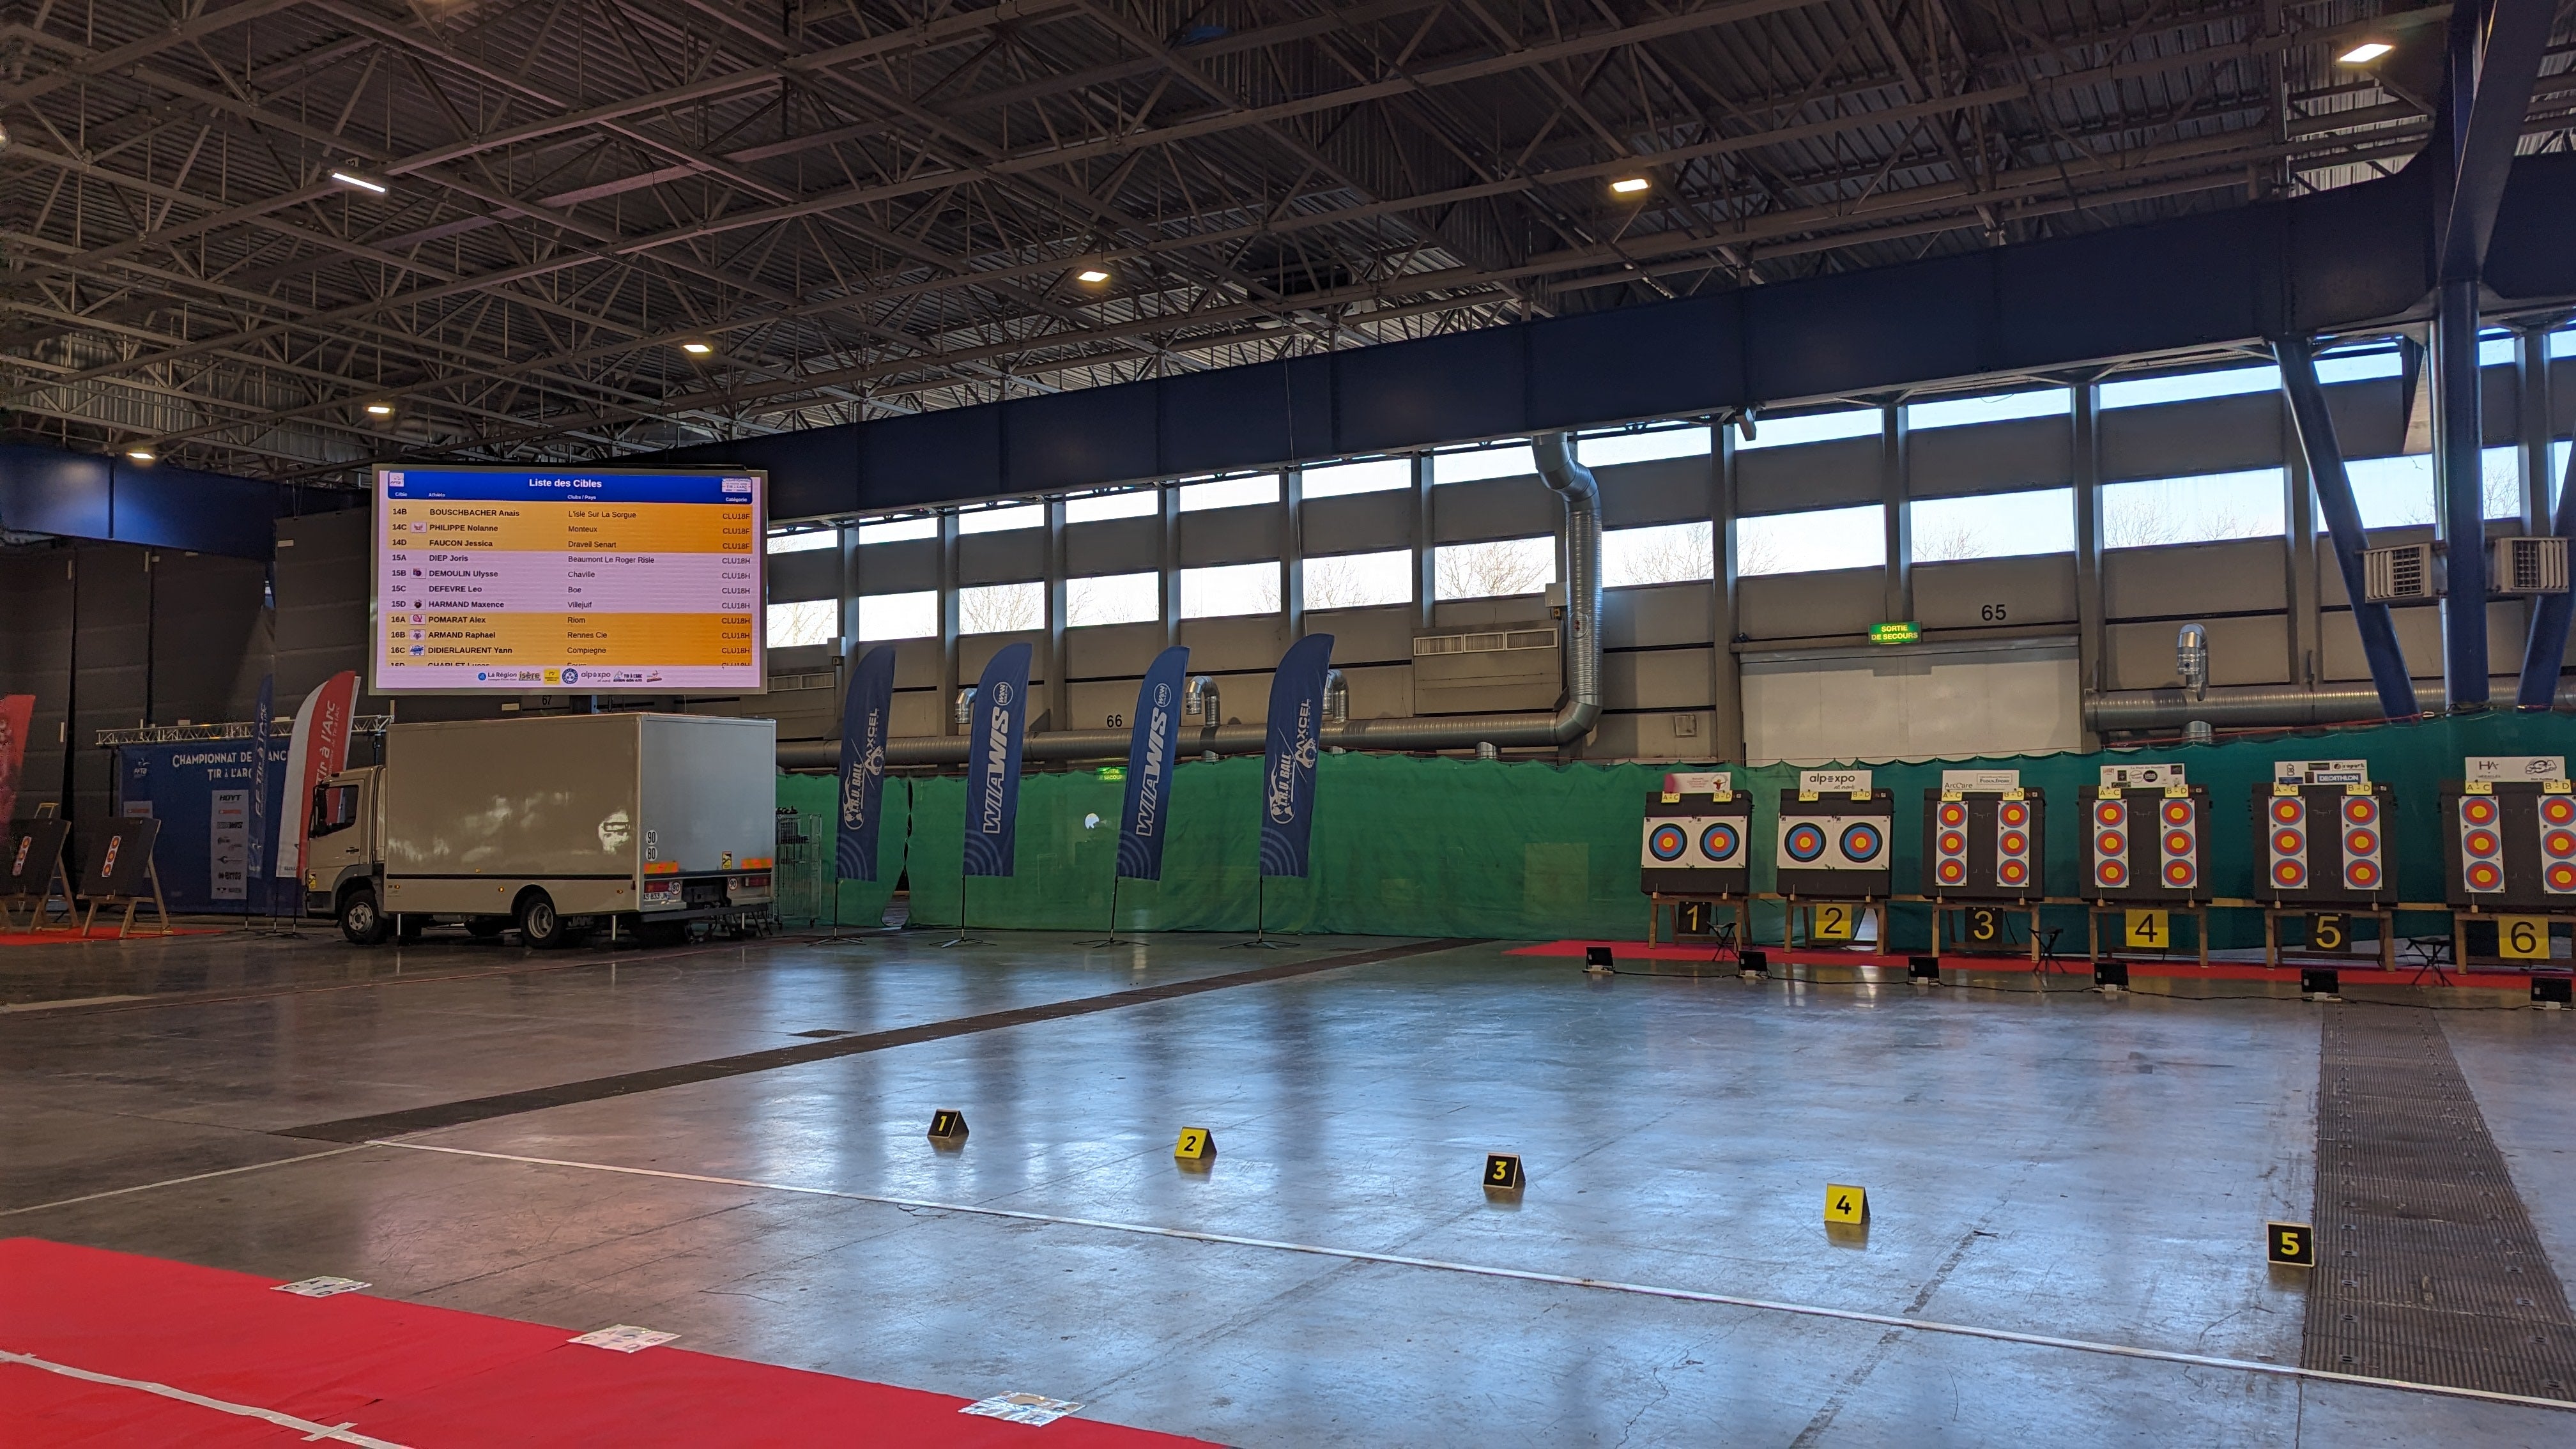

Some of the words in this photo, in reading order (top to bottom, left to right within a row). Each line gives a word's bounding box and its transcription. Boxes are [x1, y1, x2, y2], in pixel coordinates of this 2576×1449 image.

[529, 479, 551, 487] Liste
[554, 479, 571, 487] des
[573, 479, 602, 488] Cibles
[615, 556, 636, 565] Roger
[567, 601, 592, 610] Villejuif
[1981, 604, 2007, 622] 65
[465, 631, 496, 640] Raphael
[567, 647, 606, 656] Compiegne
[542, 695, 553, 705] 67
[320, 700, 336, 742] l'Arc
[1107, 714, 1123, 728] 66
[172, 752, 237, 768] CHAMPIONNAT
[240, 751, 252, 762] DE
[319, 746, 331, 759] à
[852, 762, 863, 786] BALL
[1279, 754, 1292, 778] BALL
[207, 769, 222, 781] TIR
[647, 831, 656, 844] 90
[647, 847, 656, 860] 80
[671, 884, 680, 893] 80
[729, 879, 737, 888] 90
[1686, 907, 1698, 931] 1
[1823, 907, 1843, 934] 2
[1974, 910, 1994, 940] 3
[2134, 913, 2158, 942] 4
[2316, 916, 2342, 948] 5
[2510, 921, 2536, 954] 6
[938, 1115, 948, 1131] 1
[1184, 1135, 1197, 1152] 2
[1492, 1160, 1507, 1180] 3
[1836, 1195, 1851, 1215] 4
[2280, 1231, 2300, 1255] 5
